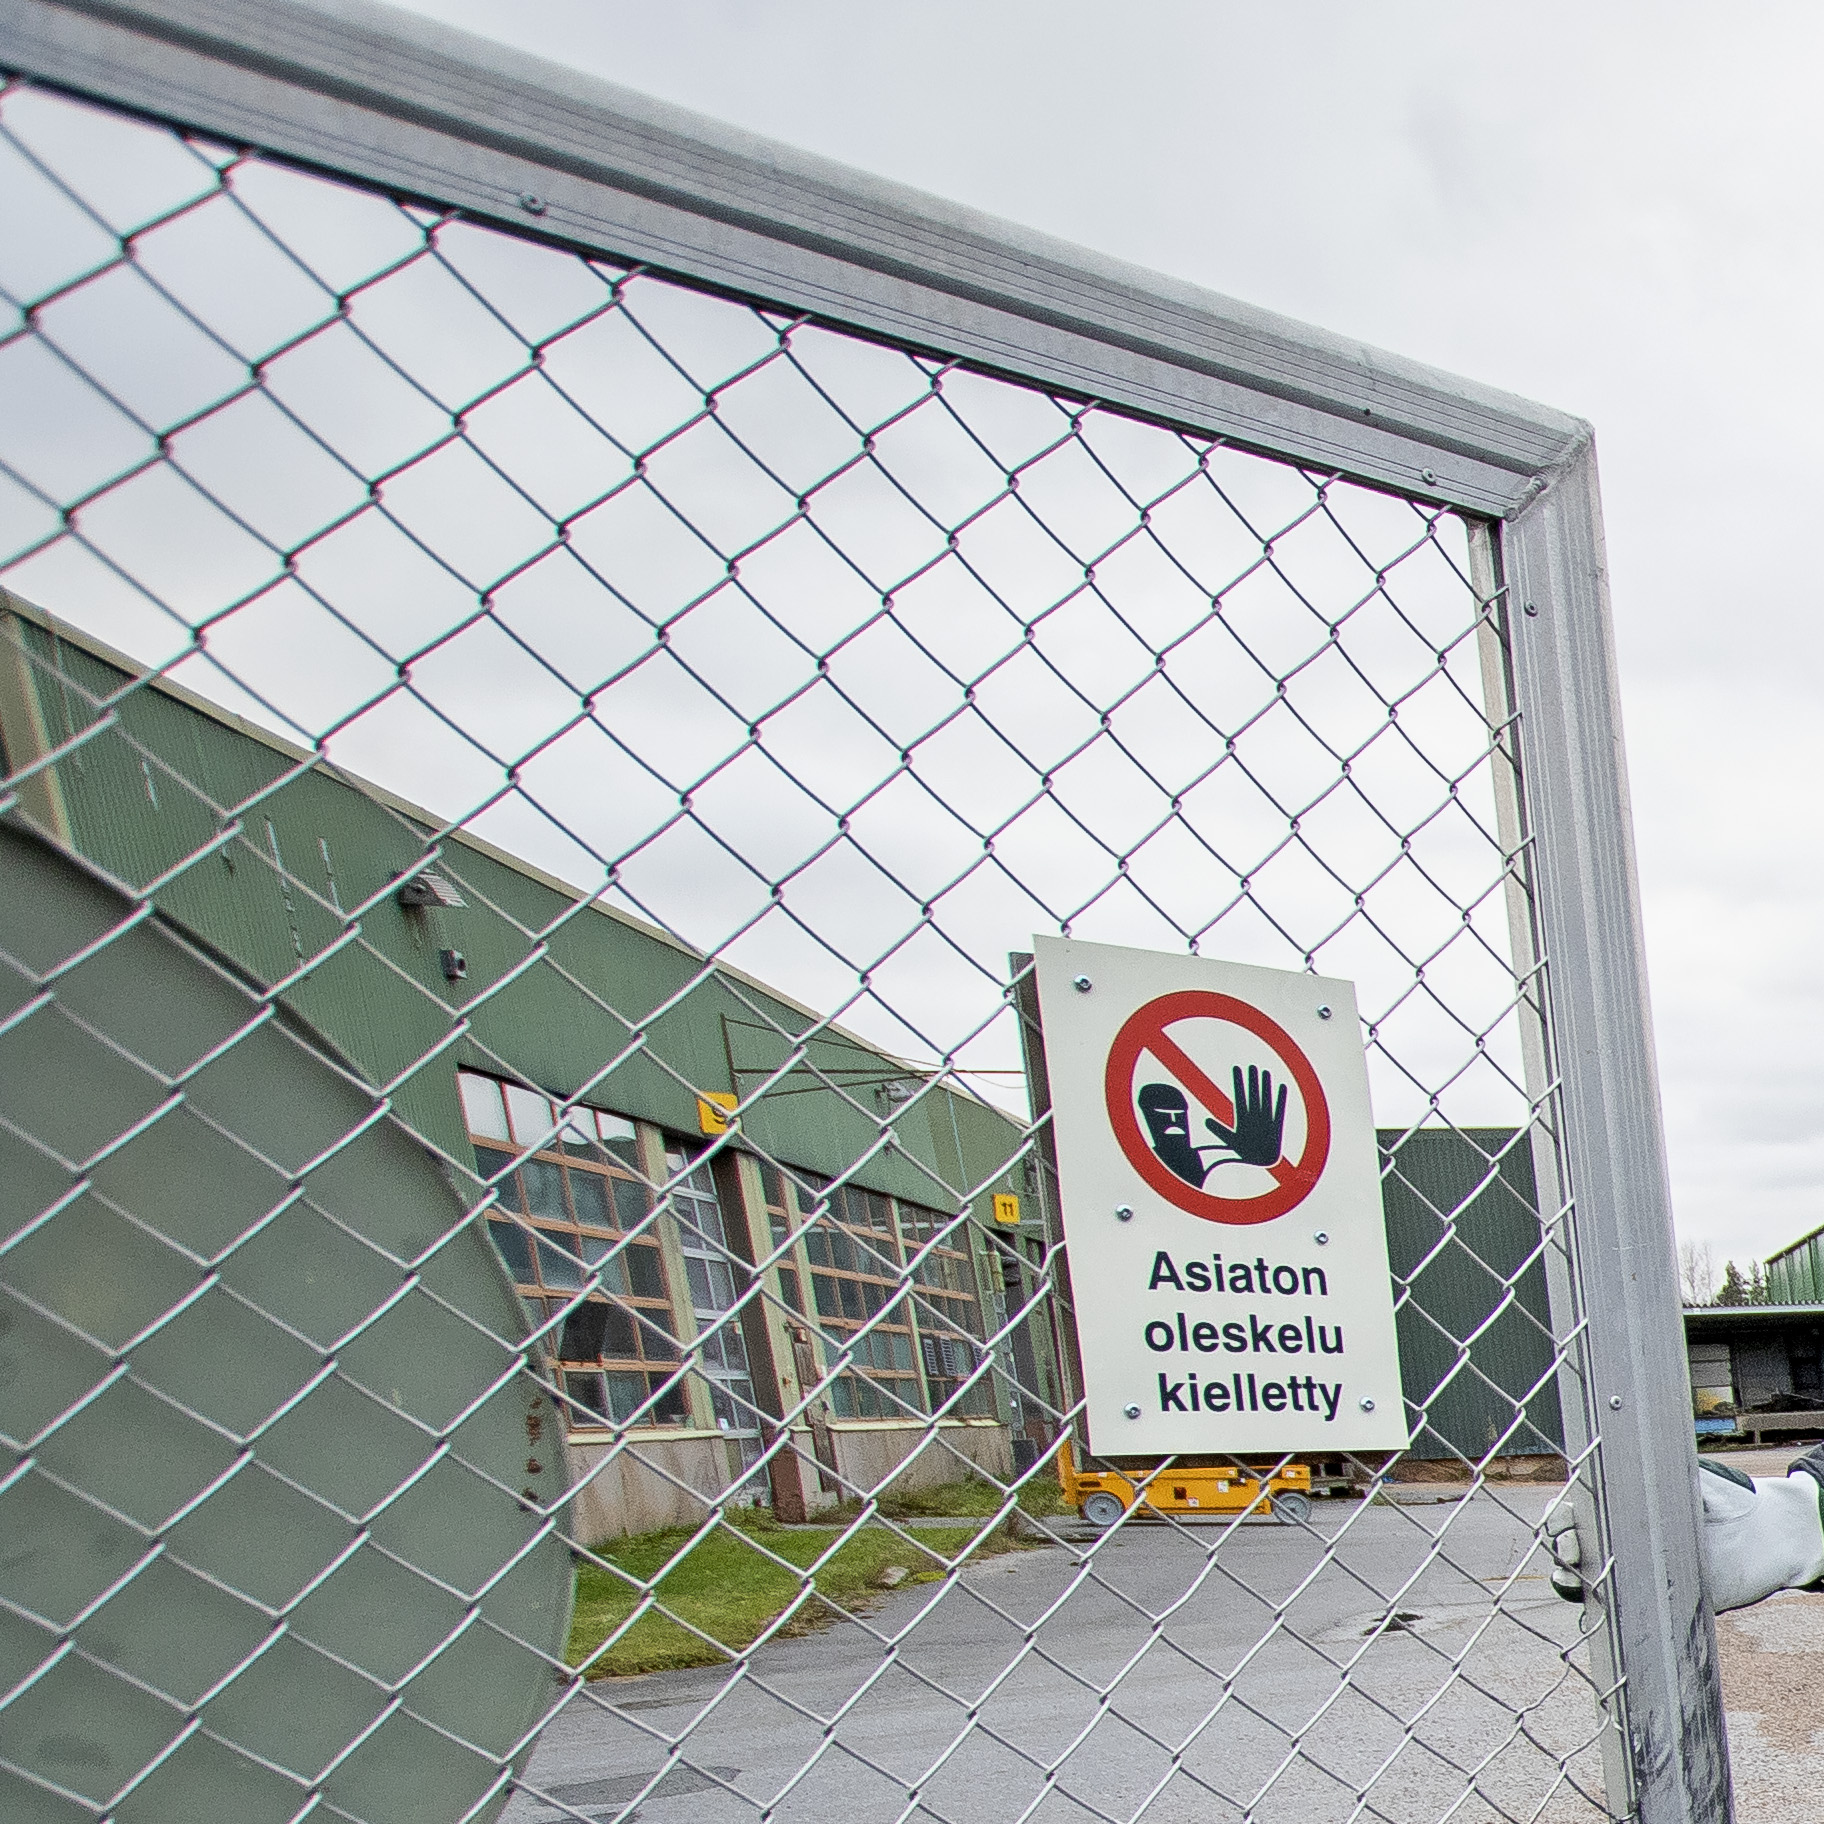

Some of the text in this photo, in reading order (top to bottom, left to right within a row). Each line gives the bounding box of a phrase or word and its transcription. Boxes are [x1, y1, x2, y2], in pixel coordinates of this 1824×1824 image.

[1148, 1250, 1329, 1297] Asiaton
[1143, 1312, 1345, 1355] oleskelu
[1157, 1372, 1343, 1422] kielletty
